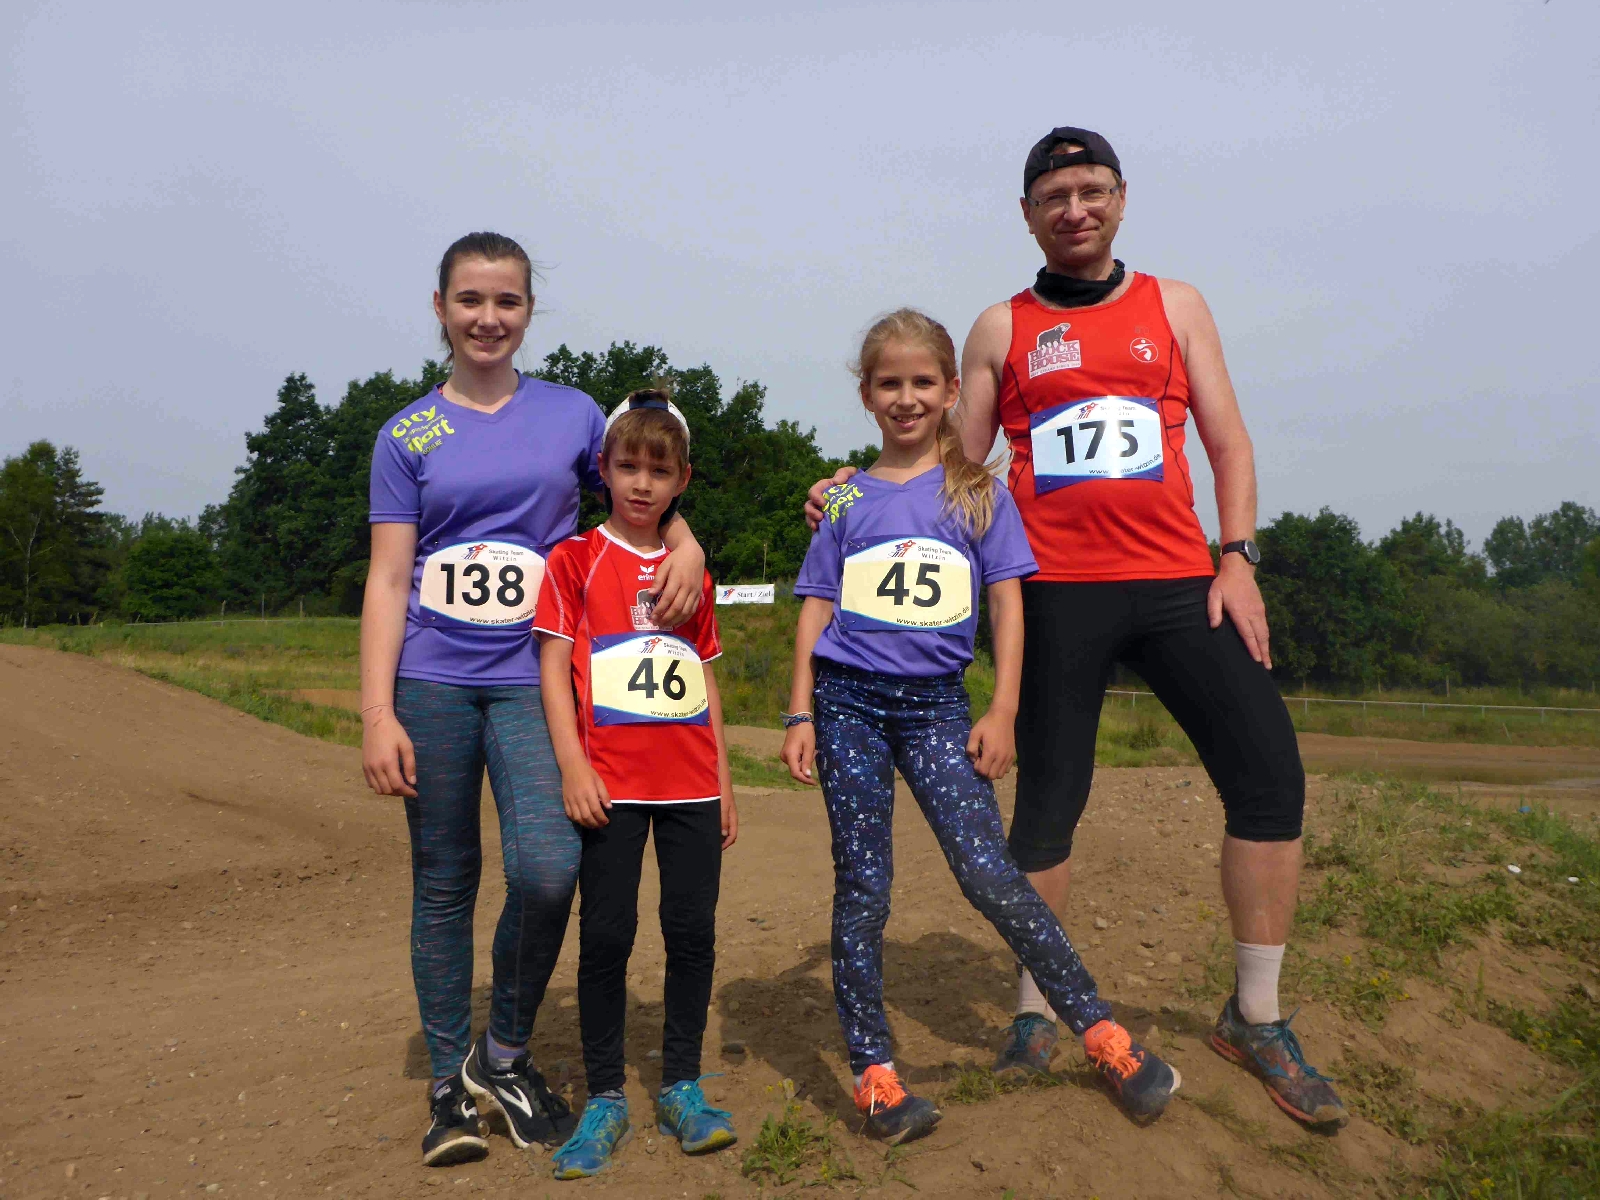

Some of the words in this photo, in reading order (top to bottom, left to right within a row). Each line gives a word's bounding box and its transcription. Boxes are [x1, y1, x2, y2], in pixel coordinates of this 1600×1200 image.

[1030, 342, 1078, 361] BLOCK
[1030, 352, 1079, 372] HOUSE
[392, 405, 436, 438] city
[1057, 419, 1139, 465] 175
[917, 546, 938, 555] Skating
[921, 553, 946, 561] Witzin
[440, 563, 525, 608] 138
[877, 562, 941, 608] 45
[896, 606, 970, 627] www.skater-witzin.de
[628, 657, 686, 701] 46
